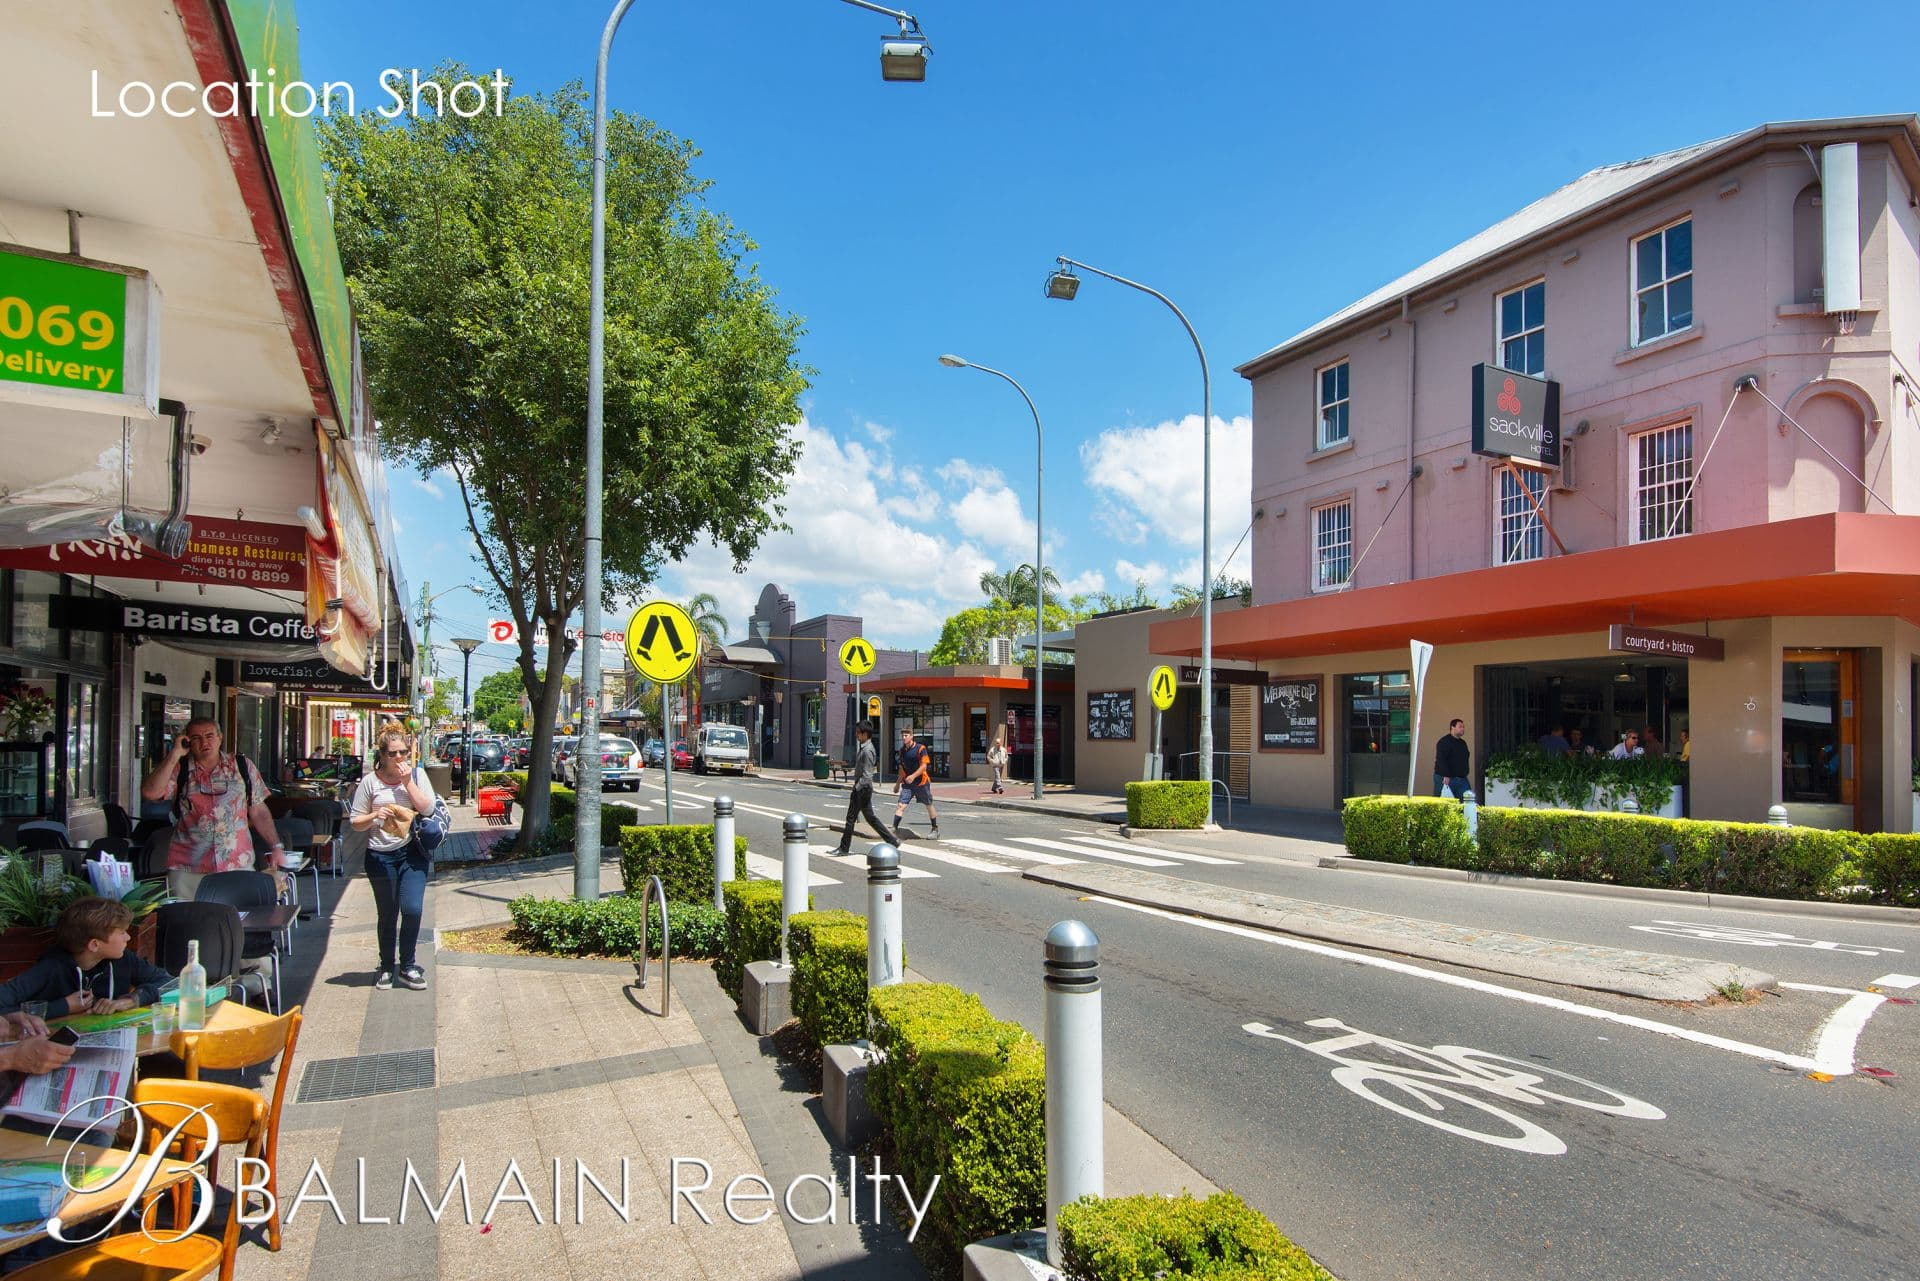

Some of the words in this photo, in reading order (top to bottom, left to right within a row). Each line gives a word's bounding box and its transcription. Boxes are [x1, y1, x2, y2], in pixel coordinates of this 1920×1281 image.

[0, 296, 114, 350] 069
[1489, 417, 1553, 444] sackville
[1530, 444, 1553, 456] HOTEL
[232, 534, 279, 544] LICENSED
[187, 540, 239, 556] tnamese
[191, 556, 212, 564] dine
[215, 556, 224, 564] in
[237, 559, 256, 568] take
[259, 562, 283, 571] away
[207, 567, 246, 580] 9810
[251, 570, 290, 584] 8899
[124, 607, 239, 635] Barista
[249, 616, 317, 639] Coffe
[1625, 636, 1664, 651] courtyard
[1672, 640, 1694, 654] bistro
[248, 665, 313, 678] love.fish
